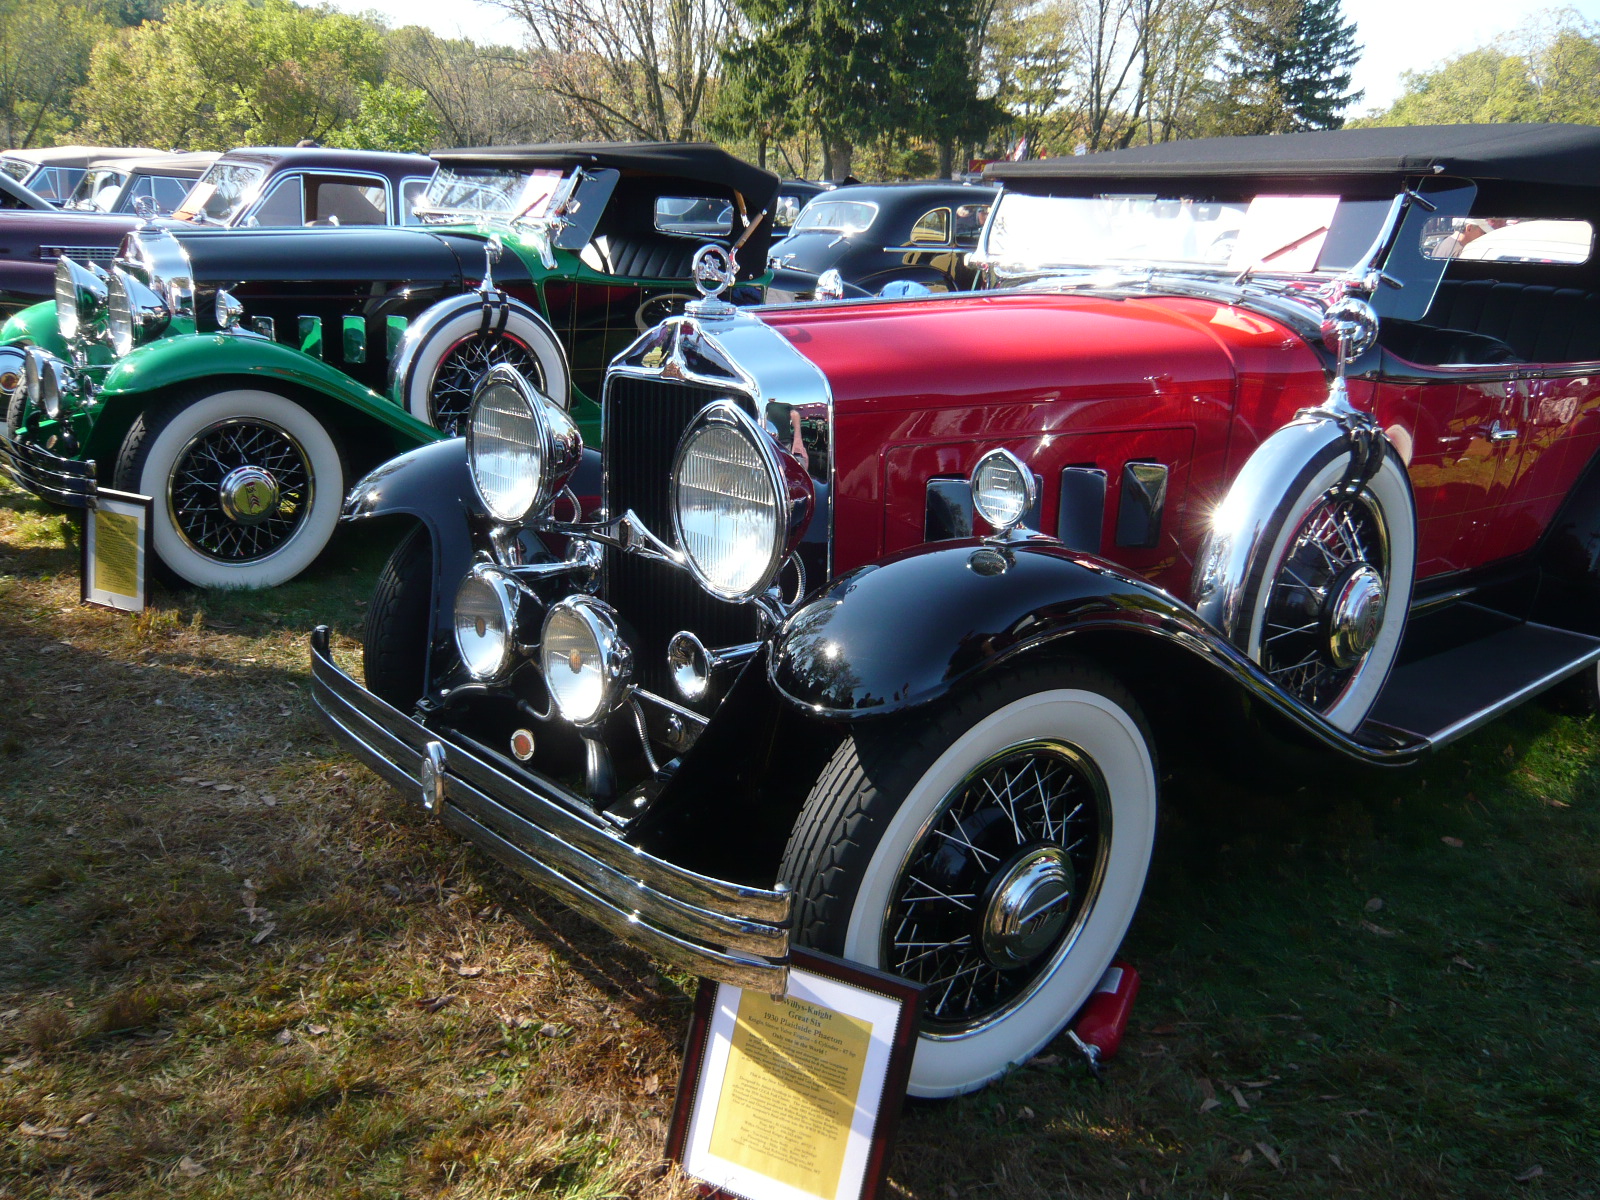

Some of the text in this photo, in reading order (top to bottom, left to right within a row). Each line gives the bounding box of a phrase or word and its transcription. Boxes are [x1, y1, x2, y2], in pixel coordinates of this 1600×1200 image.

[784, 998, 832, 1020] Willys-Knight
[788, 1010, 822, 1027] Great Six
[764, 1012, 843, 1045] 1930 Plaidside Phaeton
